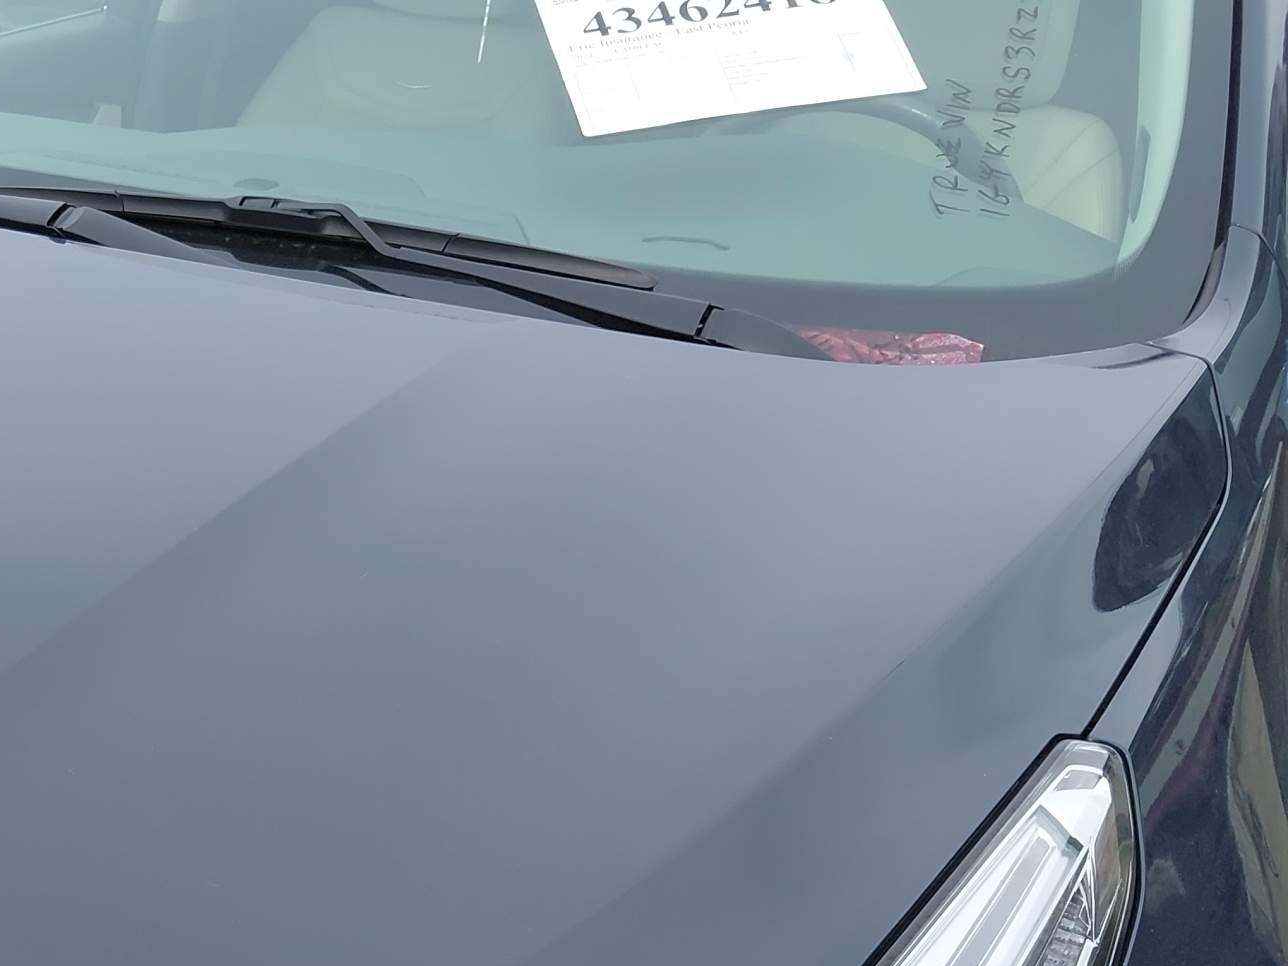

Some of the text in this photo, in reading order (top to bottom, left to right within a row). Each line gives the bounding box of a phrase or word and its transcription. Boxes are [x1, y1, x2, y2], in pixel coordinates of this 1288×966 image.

[583, 0, 835, 36] 434624
[936, 79, 972, 128] VIN
[979, 0, 1038, 216] 1GYKNDRS3RZ
